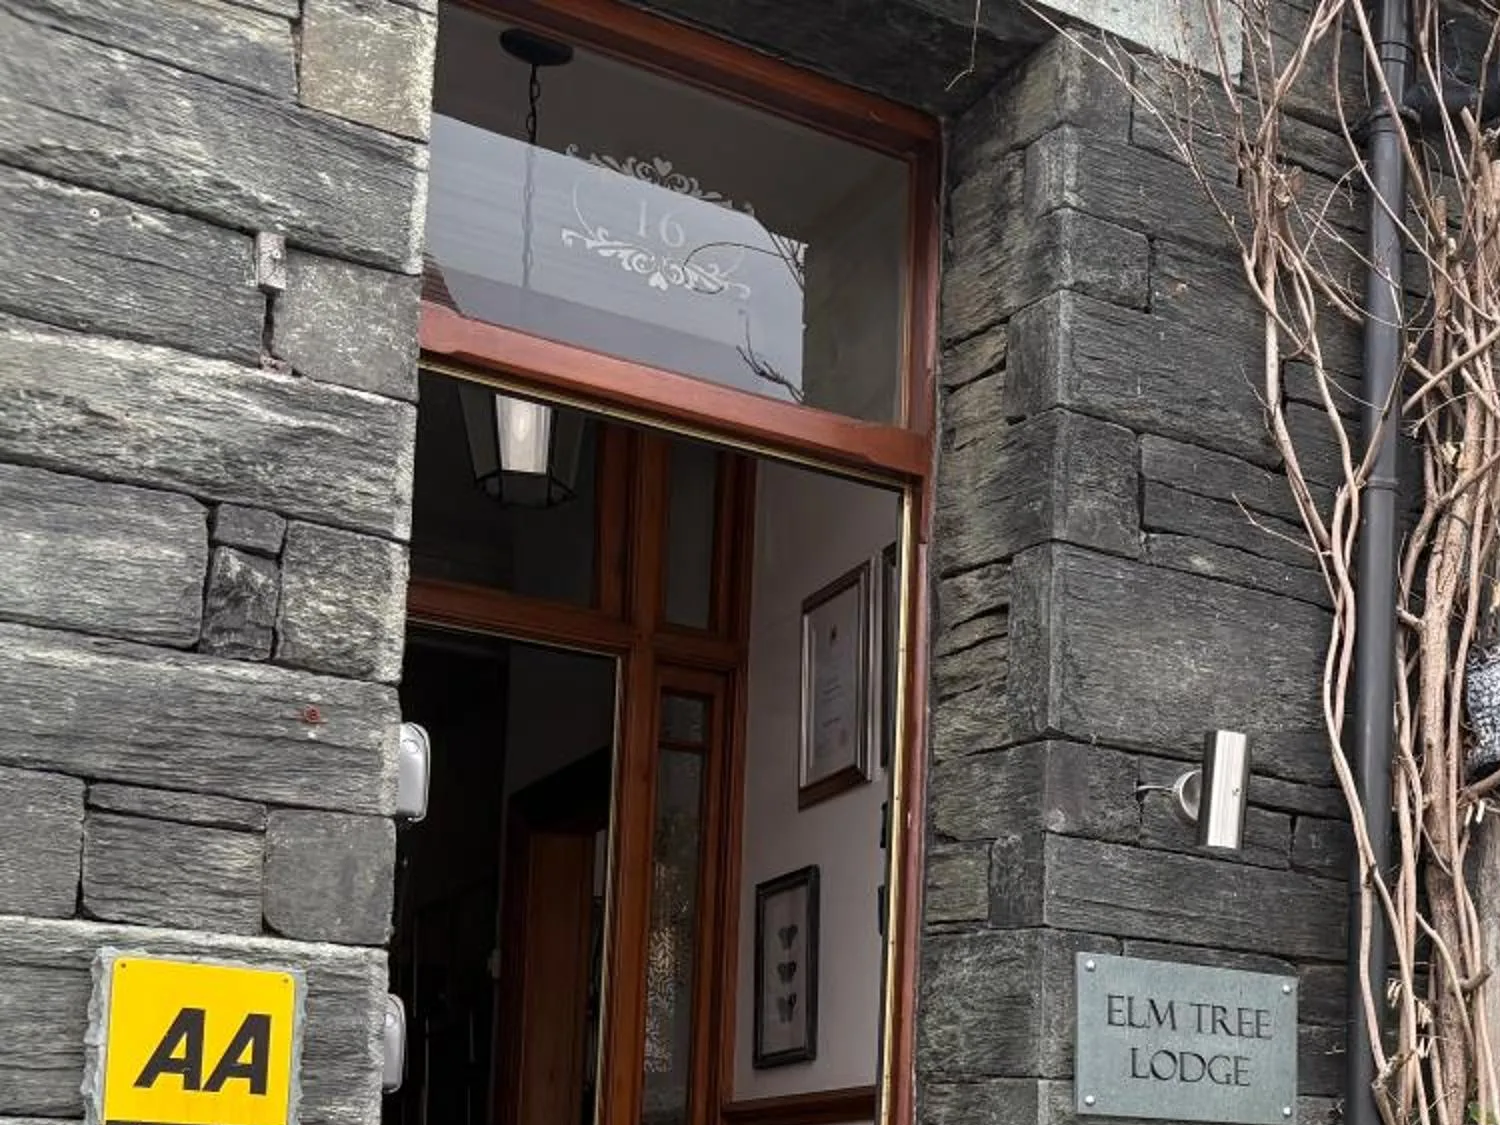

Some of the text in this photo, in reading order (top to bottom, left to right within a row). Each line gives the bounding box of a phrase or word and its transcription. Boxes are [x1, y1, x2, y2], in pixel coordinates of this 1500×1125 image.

[637, 198, 685, 249] 16
[1106, 994, 1273, 1040] ELM TREE
[133, 1007, 272, 1096] AA
[1130, 1047, 1251, 1087] LODGE
